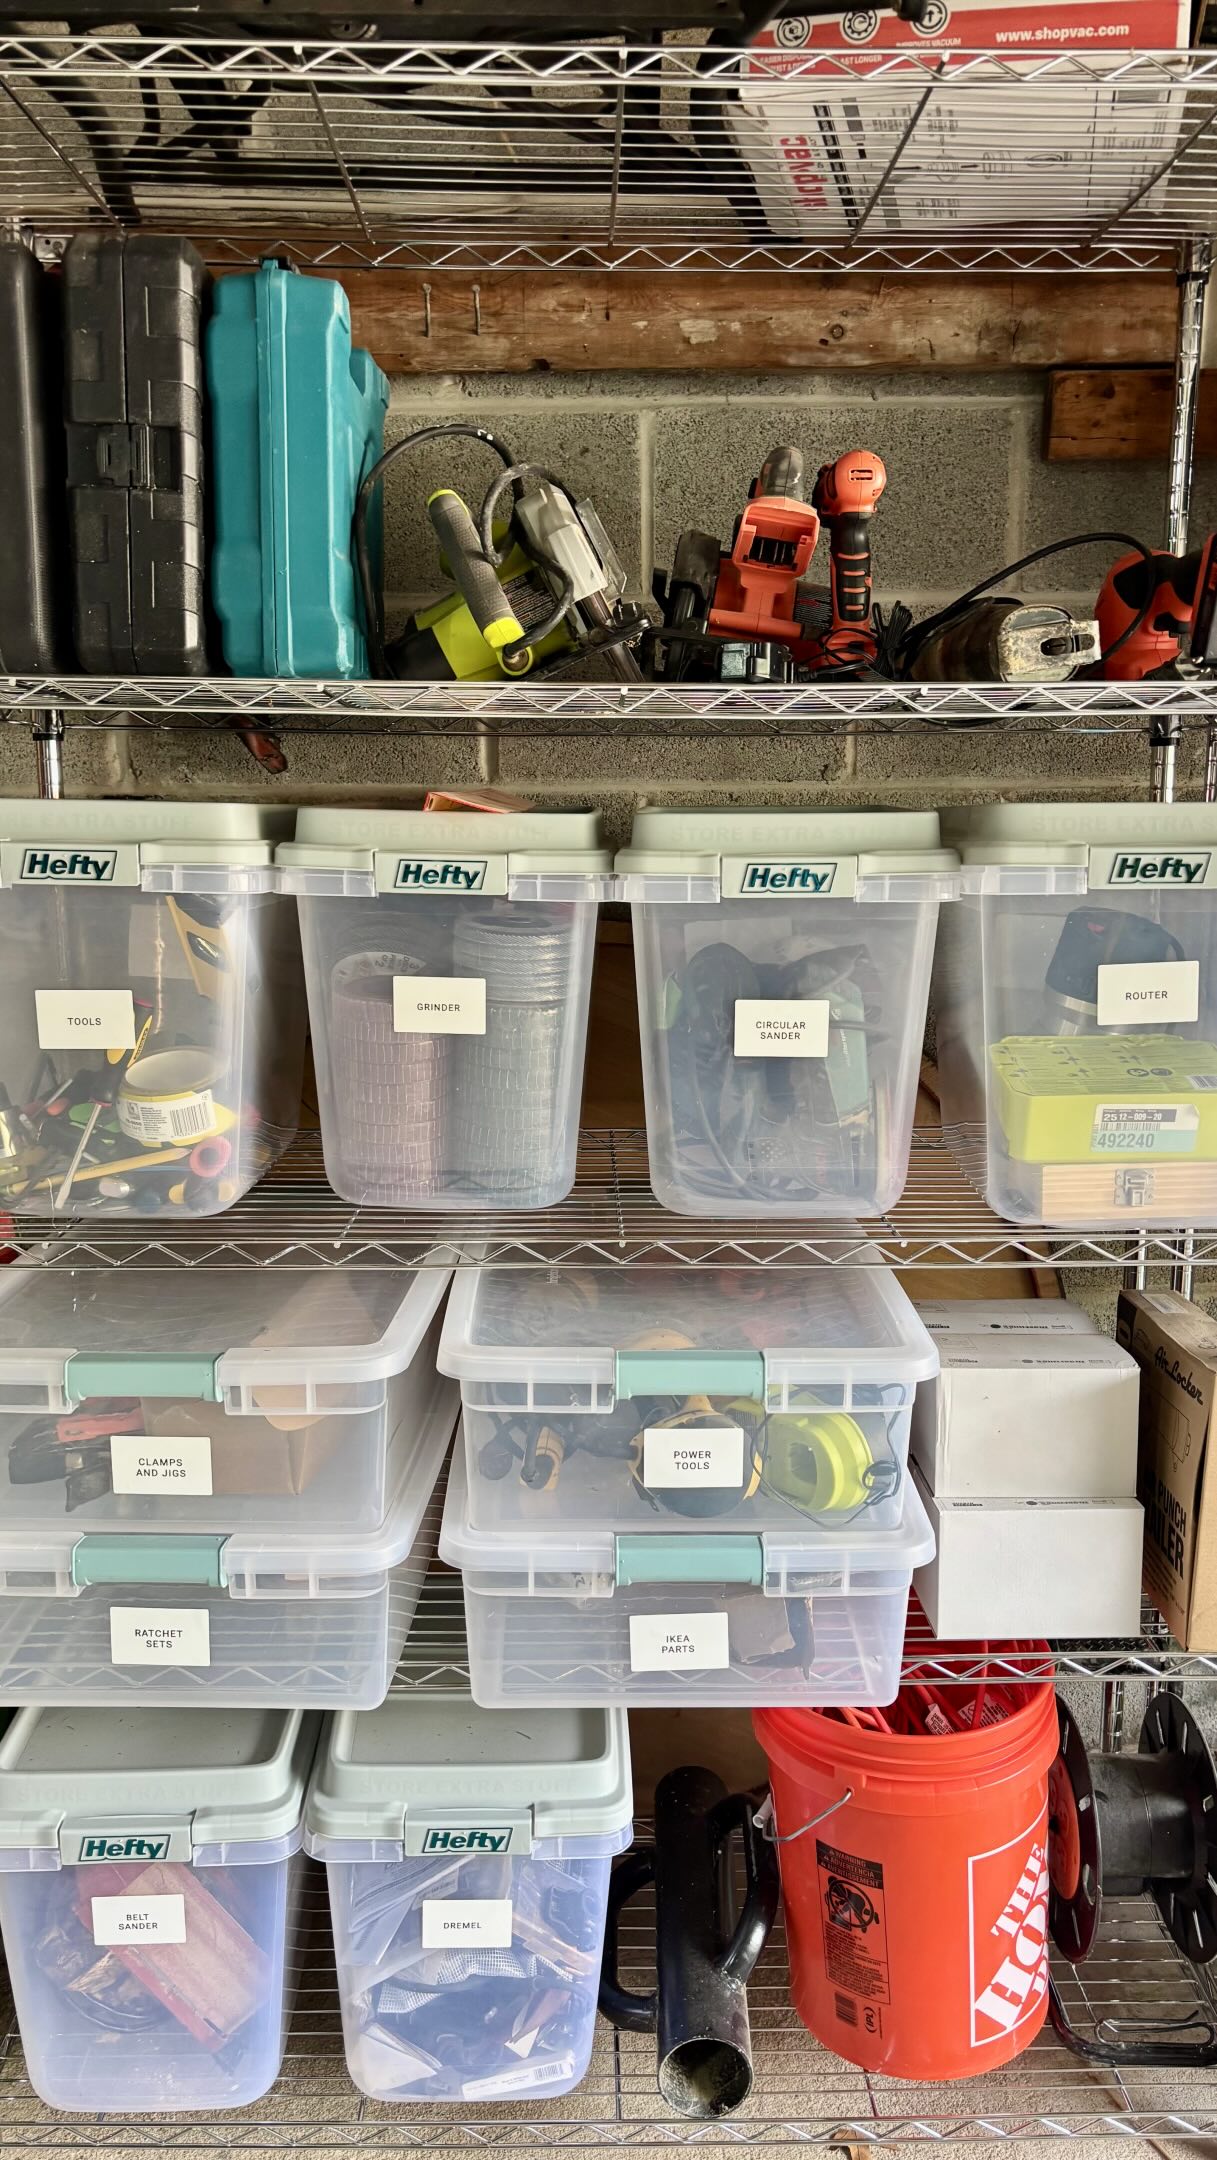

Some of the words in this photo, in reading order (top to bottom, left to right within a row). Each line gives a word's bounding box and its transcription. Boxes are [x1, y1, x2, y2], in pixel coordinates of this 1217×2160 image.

[995, 24, 1130, 43] www.shopvac.com
[27, 853, 110, 880] Hefty
[1117, 857, 1203, 883] Hefty
[401, 861, 481, 889] Hefty
[750, 867, 829, 892] Hefty
[1125, 990, 1168, 1001] ROUTER
[416, 1002, 461, 1012] GRINDER
[66, 1016, 102, 1026] TOOLS
[755, 1020, 807, 1030] CIRCULAR
[760, 1030, 801, 1040] SANDER
[1097, 1132, 1155, 1148] 492240
[673, 1450, 712, 1459] POWER
[138, 1457, 183, 1467] CLAMPS
[674, 1461, 711, 1471] TOOLS
[135, 1468, 159, 1478] AND
[161, 1468, 187, 1478] JIGS
[1157, 1479, 1187, 1538] PUNCH
[134, 1628, 183, 1638] RATCHET
[145, 1639, 173, 1649] SETS
[665, 1634, 691, 1644] IKEA
[661, 1644, 696, 1654] PARTS
[428, 1831, 506, 1851] Hefty
[86, 1838, 164, 1859] Hefty
[990, 1842, 1044, 1939] THE
[126, 1913, 150, 1922] BELT
[117, 1922, 158, 1932] SANDER
[442, 1921, 482, 1931] DREMEL
[975, 1868, 1049, 2030] HO
